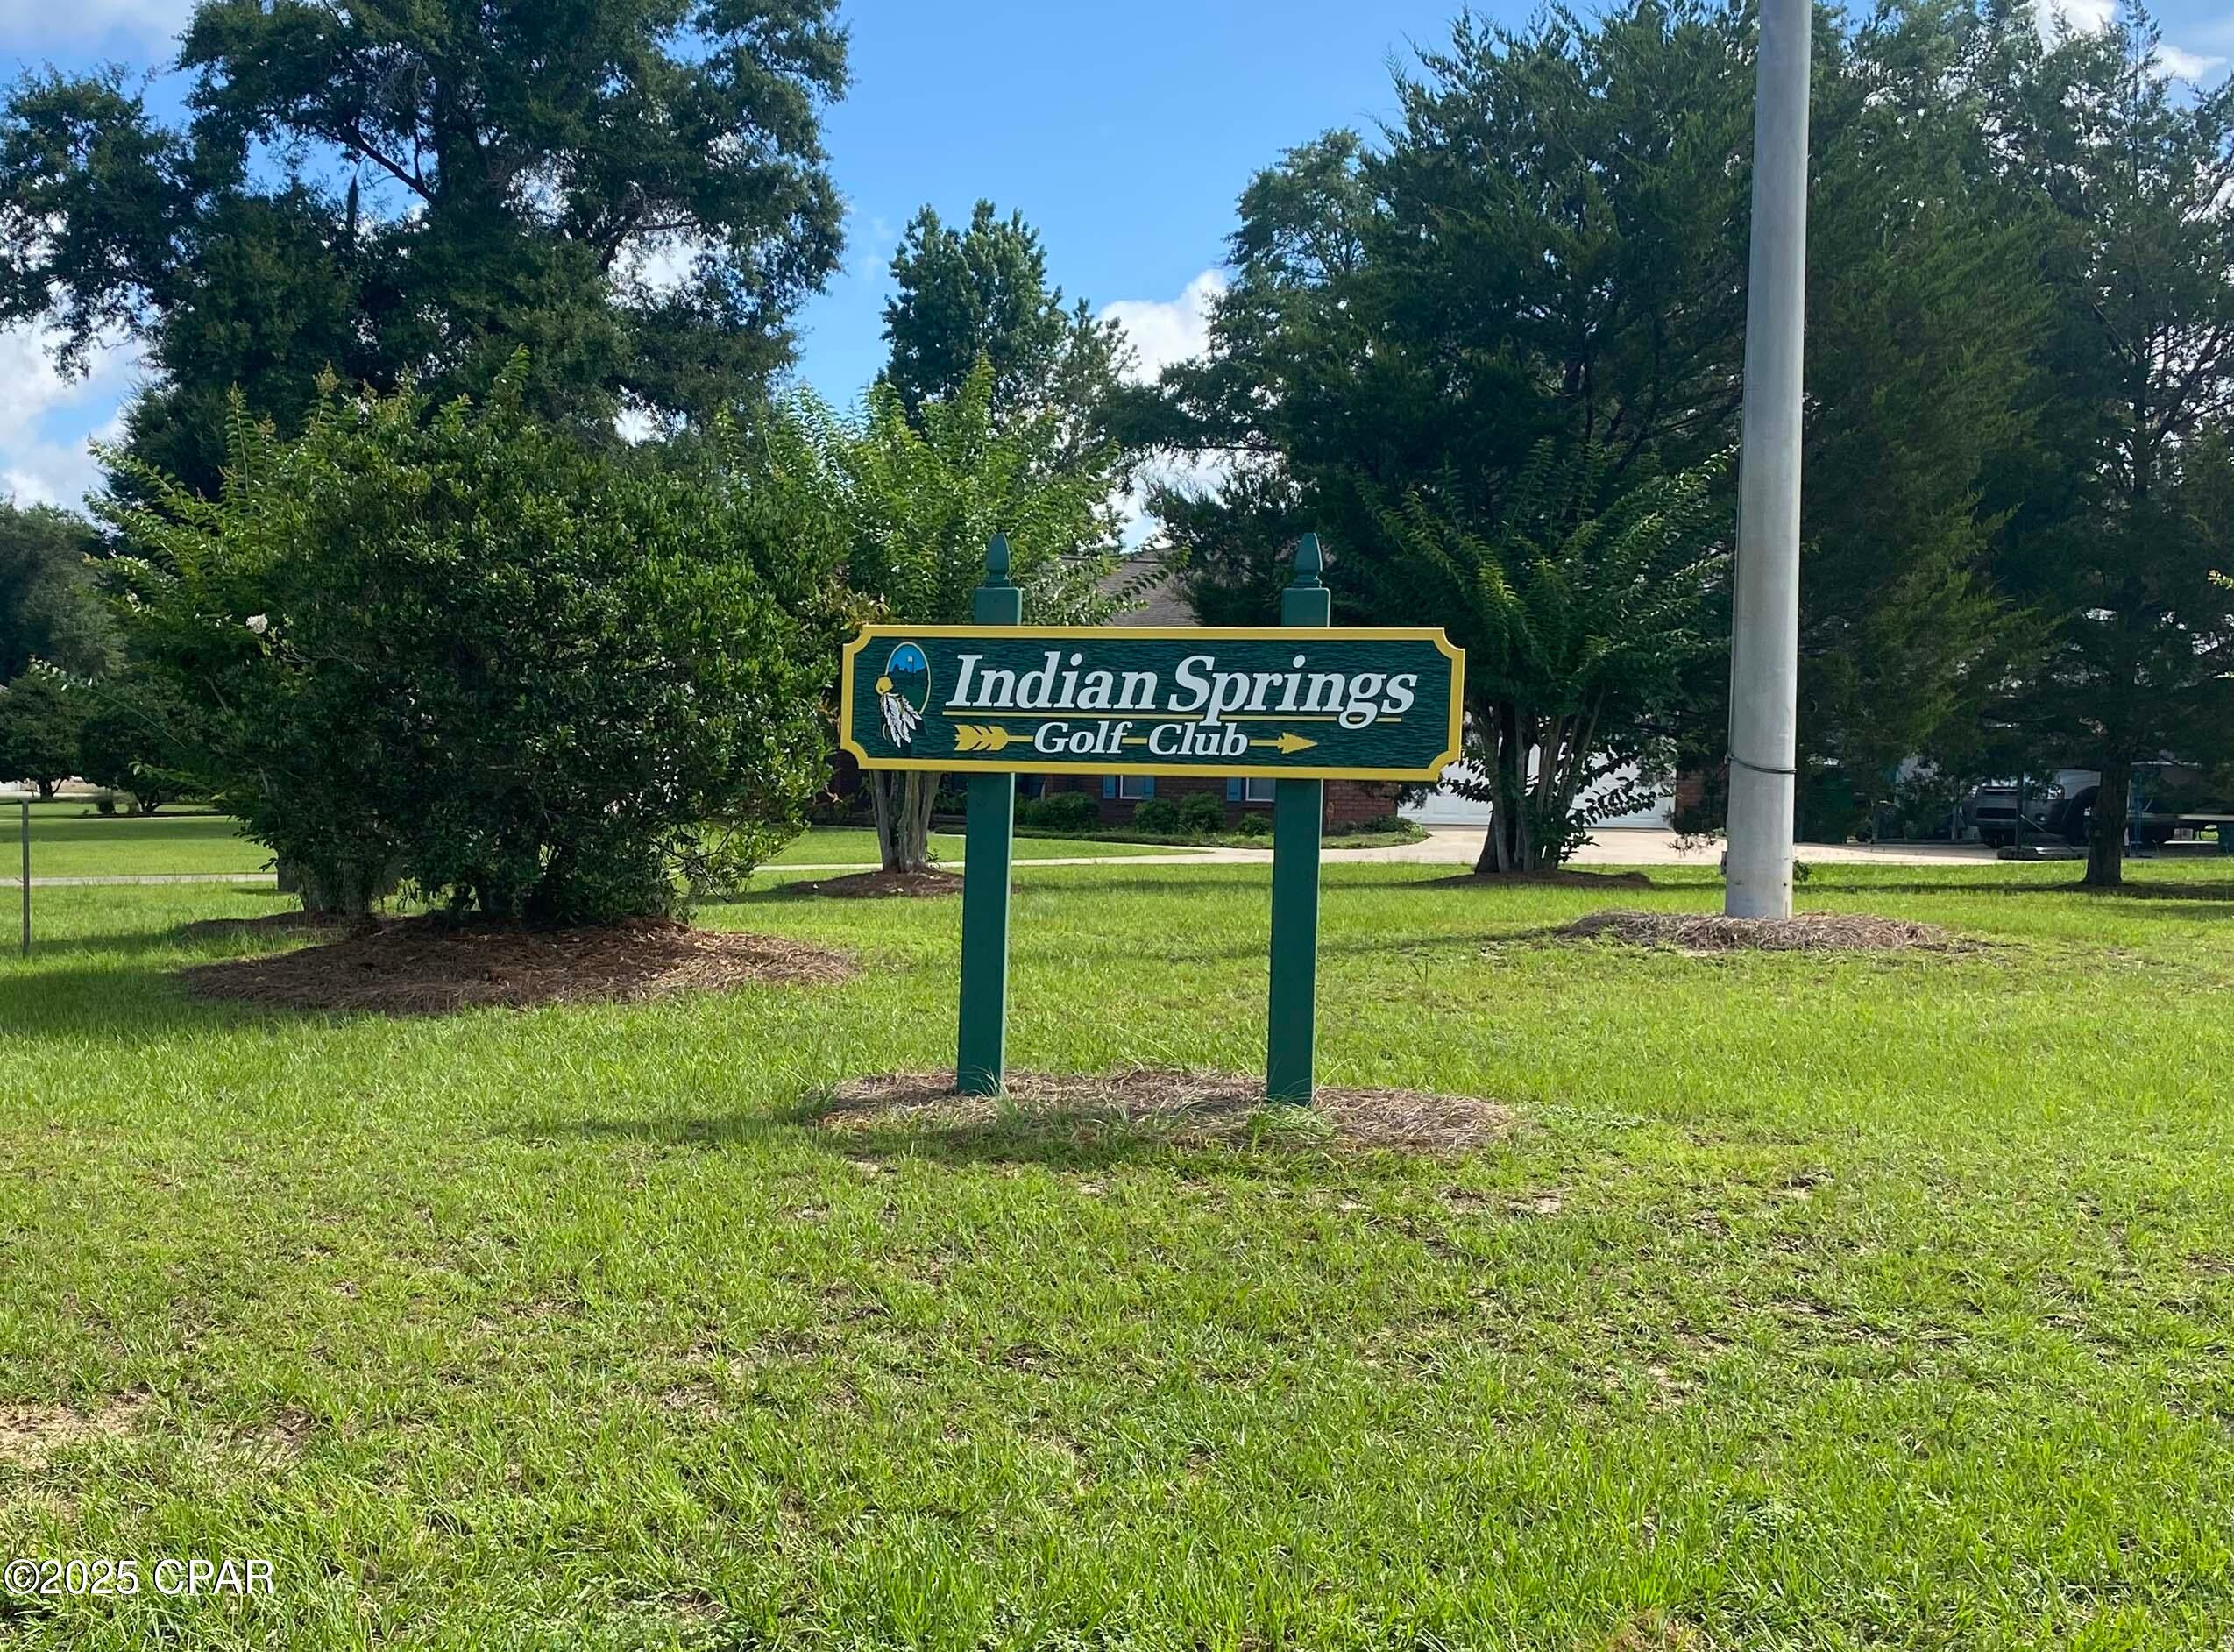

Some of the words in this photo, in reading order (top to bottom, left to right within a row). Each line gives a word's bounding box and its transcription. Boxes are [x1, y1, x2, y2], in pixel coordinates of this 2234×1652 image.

[945, 650, 1156, 712] Indian
[1167, 654, 1418, 729] Springs
[1033, 720, 1132, 755] Golf
[1147, 721, 1251, 756] Club
